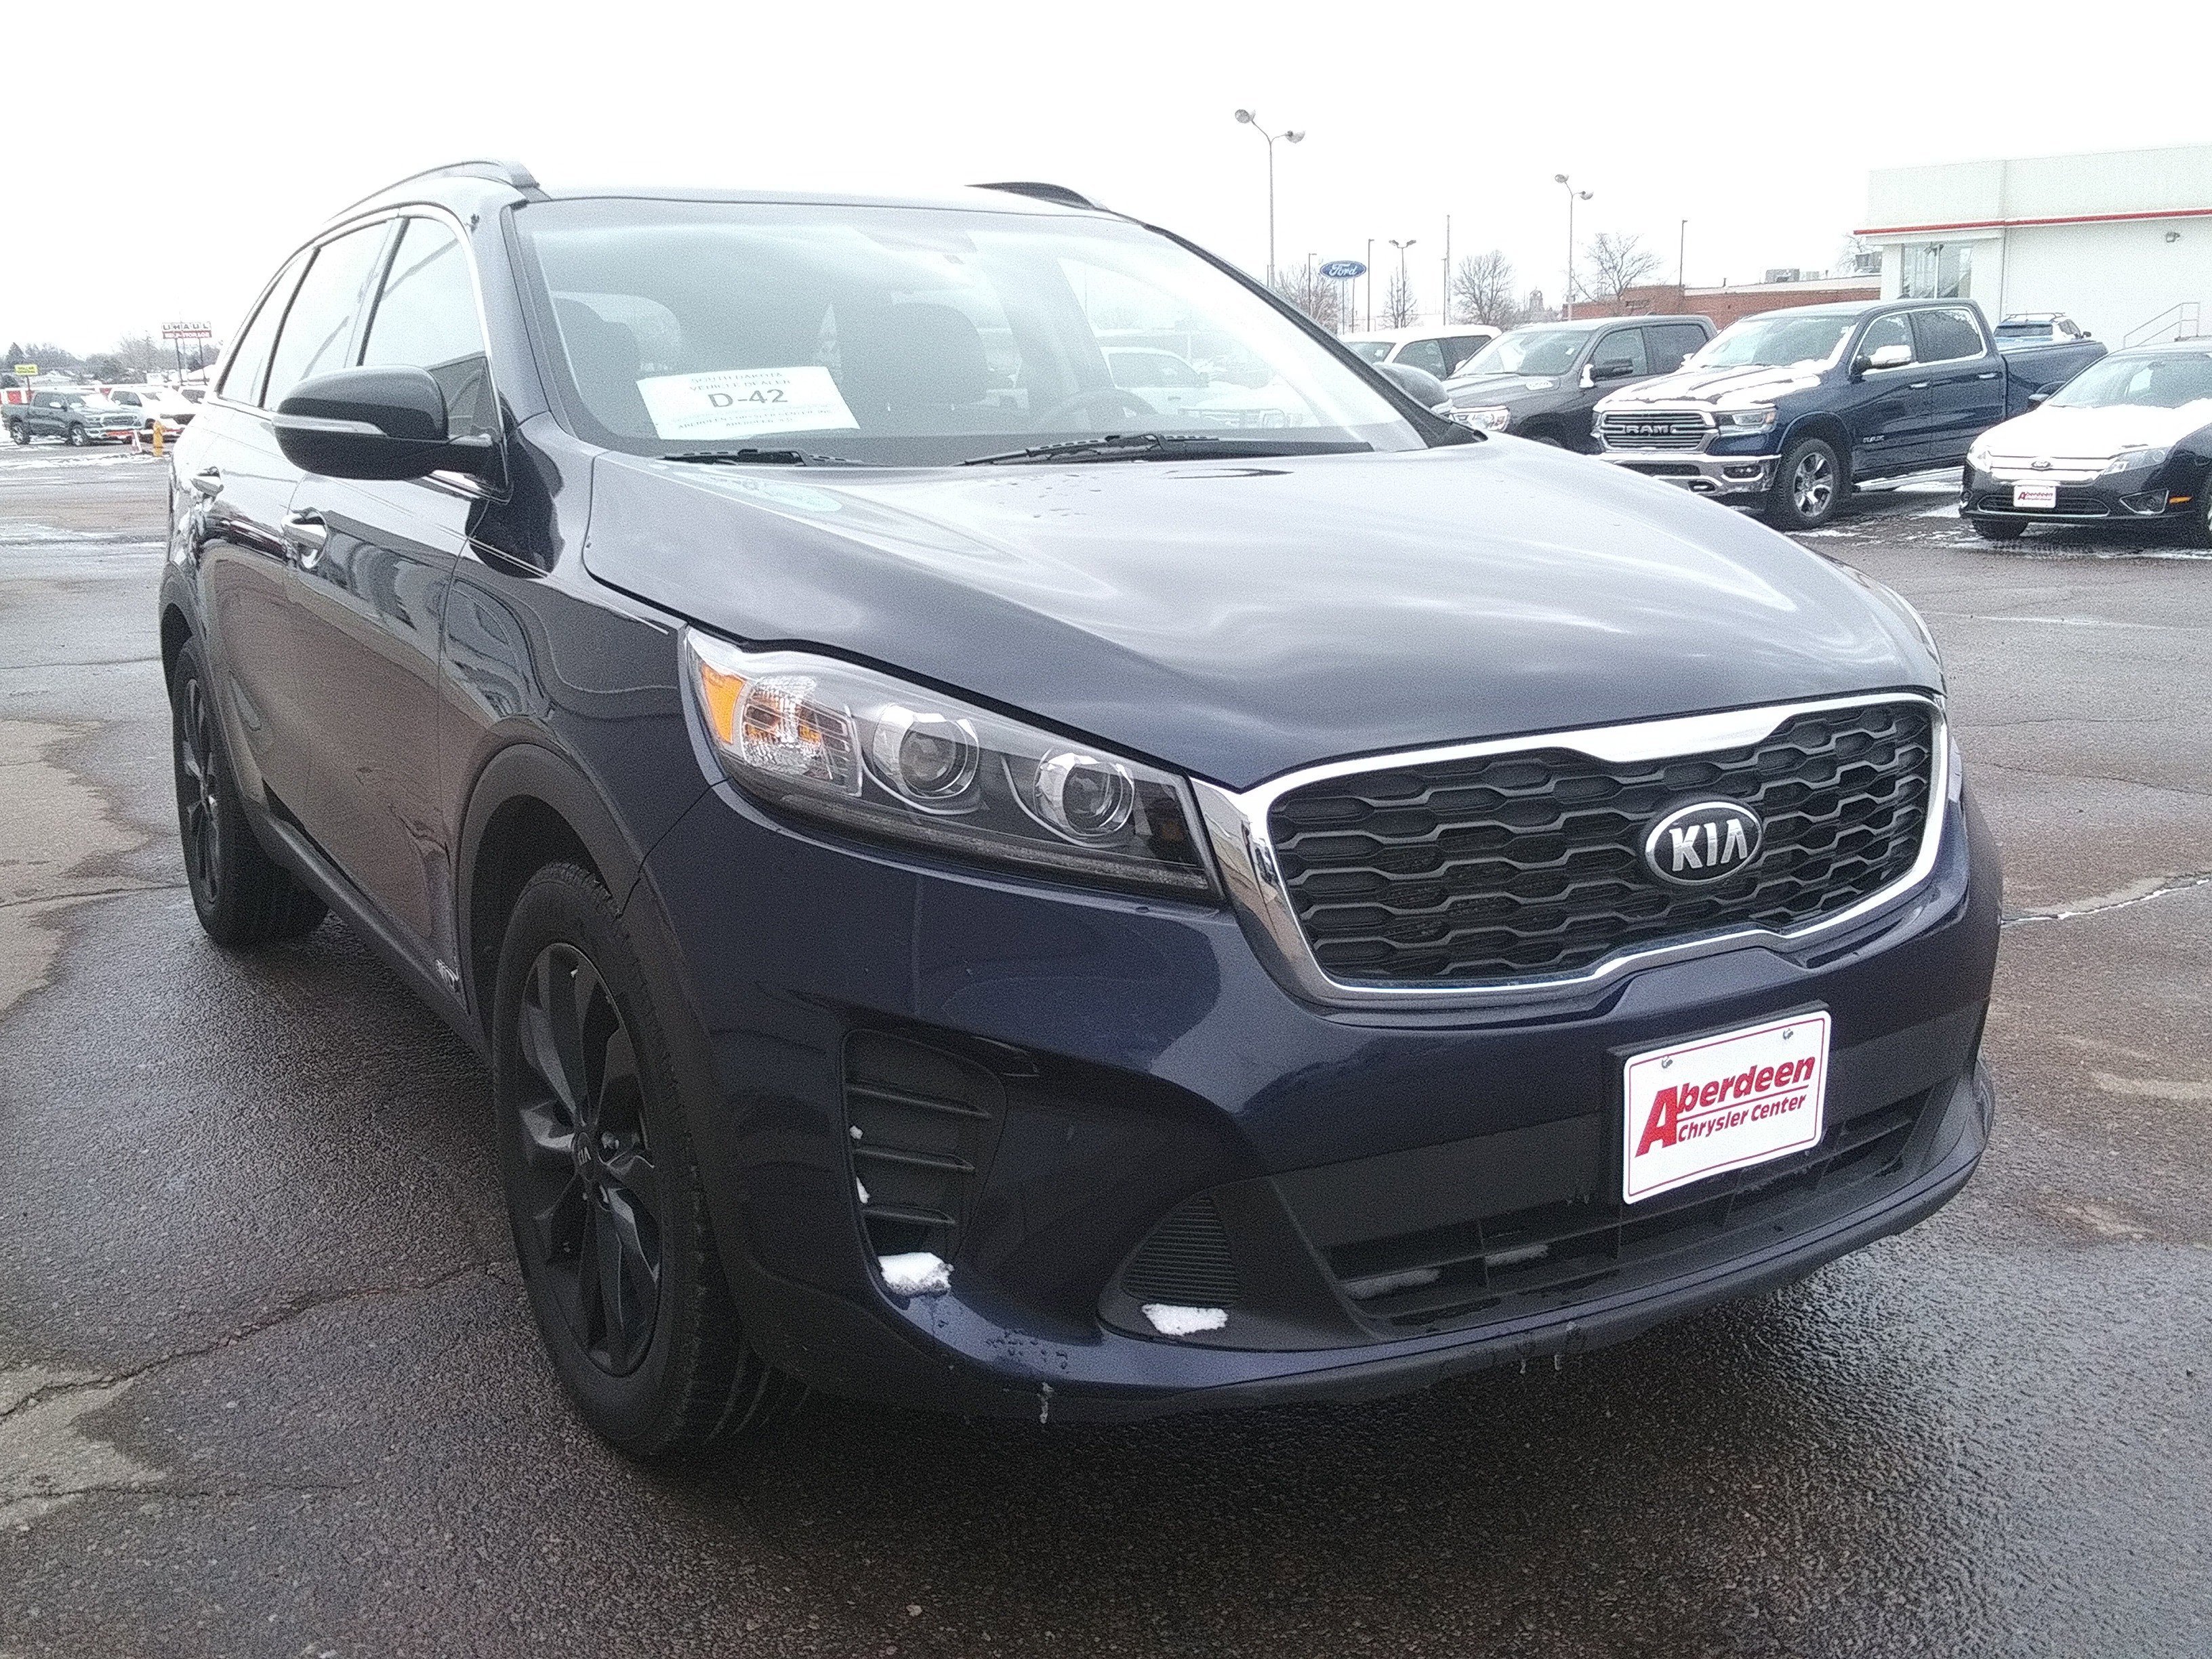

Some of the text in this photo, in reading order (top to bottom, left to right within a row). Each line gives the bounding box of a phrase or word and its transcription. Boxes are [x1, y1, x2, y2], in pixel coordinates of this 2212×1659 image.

[1329, 263, 1357, 276] Ford
[708, 388, 788, 408] D-42
[1624, 425, 1672, 434] RAM
[1668, 818, 1748, 872] KIA
[1635, 1056, 1816, 1158] Aberdeen
[1677, 1094, 1807, 1143] Chrysler Center
